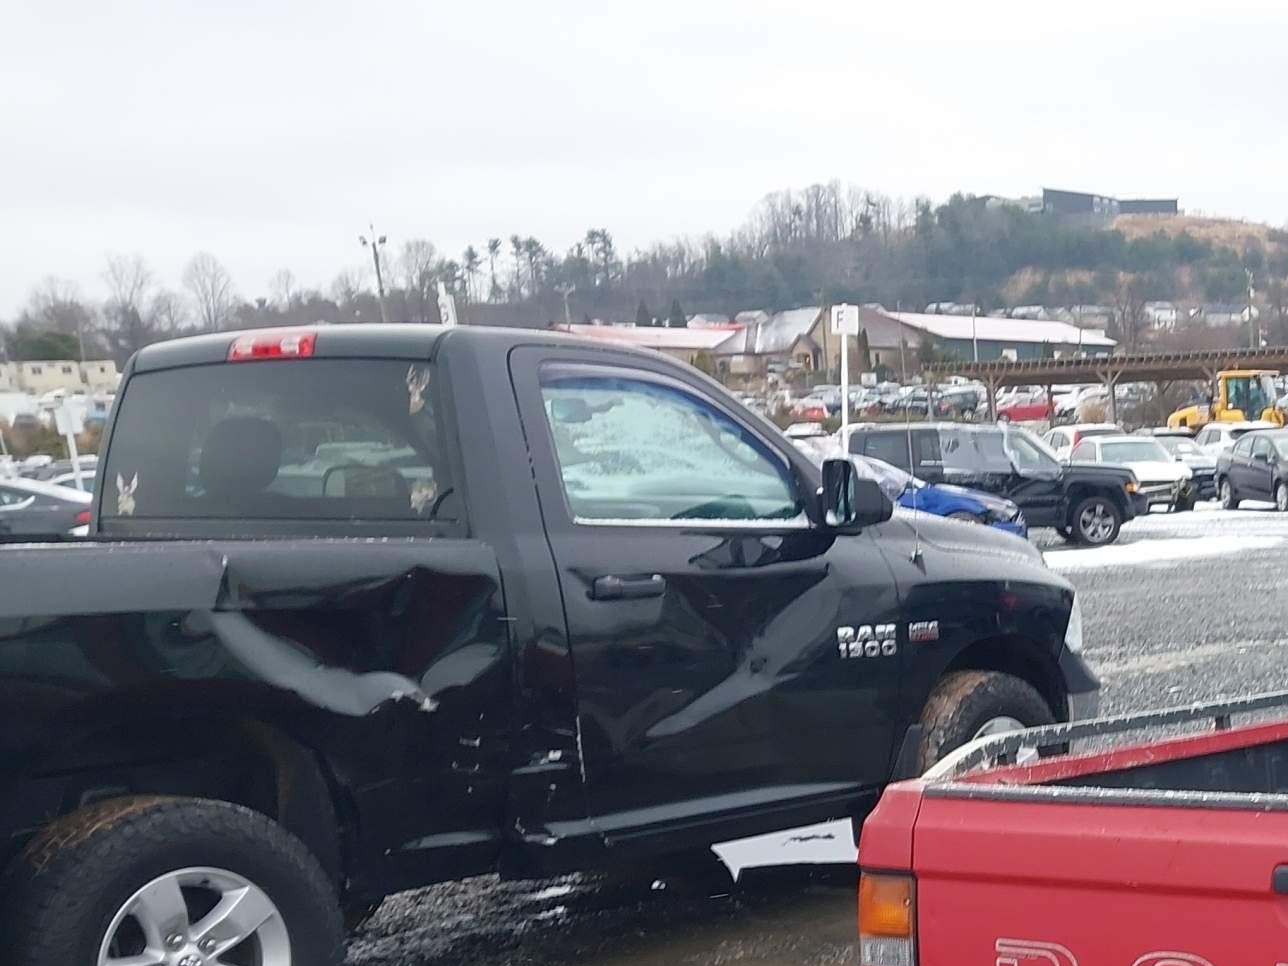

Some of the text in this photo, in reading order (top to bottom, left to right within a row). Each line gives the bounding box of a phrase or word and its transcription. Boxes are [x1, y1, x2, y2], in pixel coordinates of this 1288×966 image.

[836, 310, 844, 329] F
[837, 624, 897, 643] RAM
[838, 639, 897, 659] 1500
